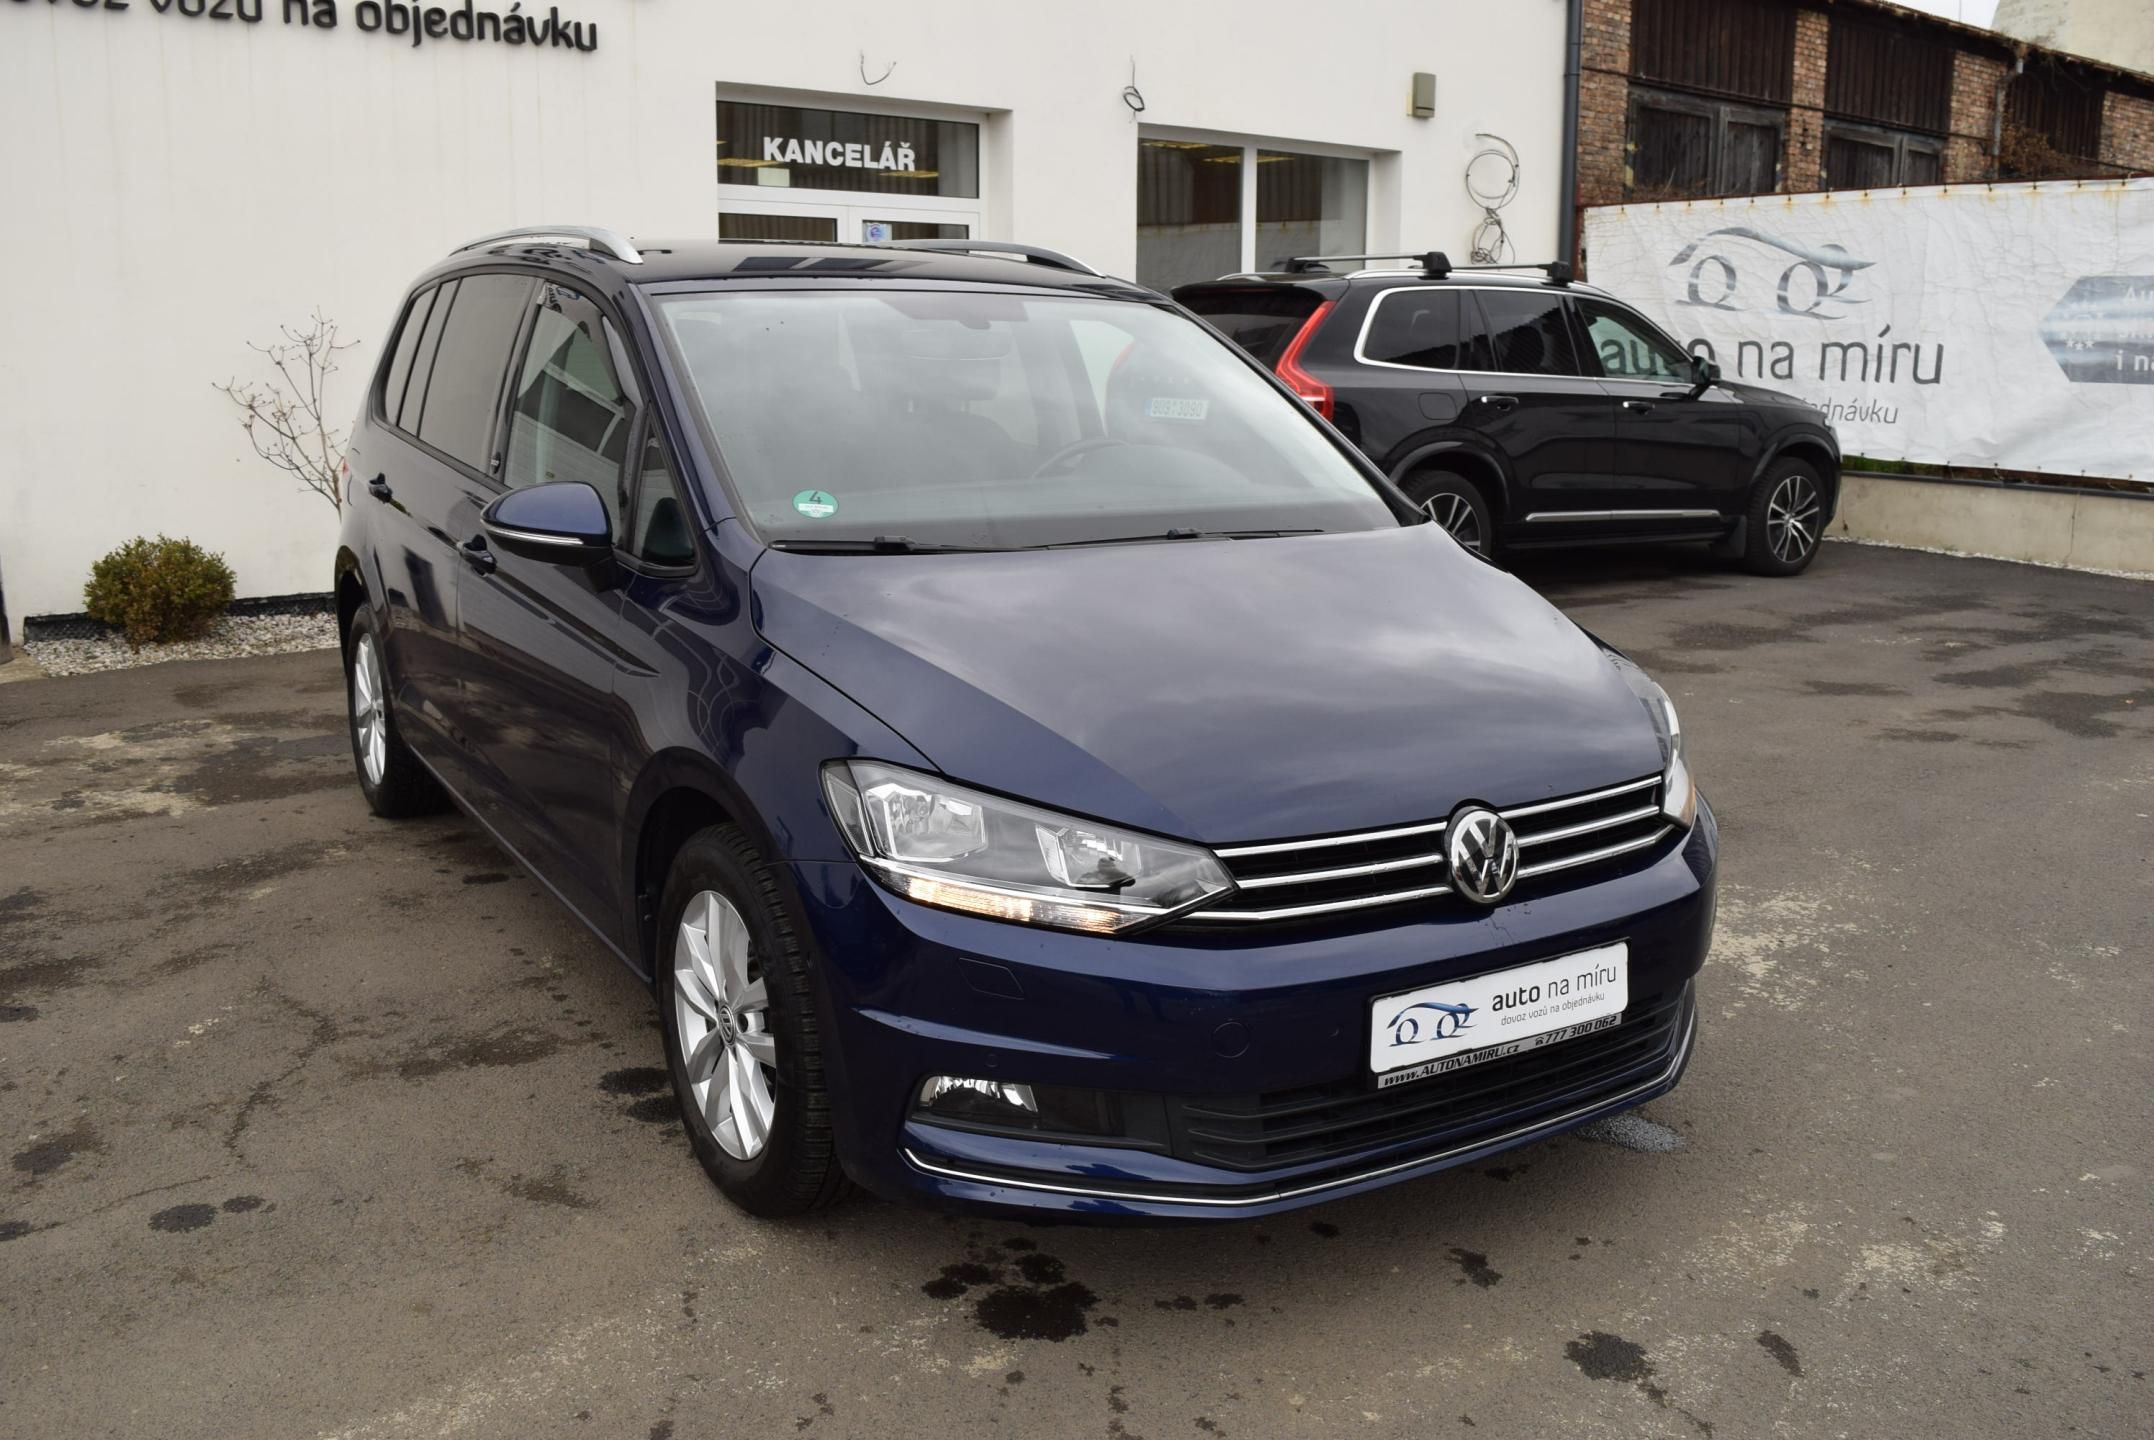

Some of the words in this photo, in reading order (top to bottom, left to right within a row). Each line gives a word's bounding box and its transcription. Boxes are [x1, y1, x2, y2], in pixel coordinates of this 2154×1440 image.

[283, 0, 337, 28] na
[355, 0, 597, 50] objednávku
[763, 136, 916, 172] KANCELÁŘ
[1600, 338, 1716, 376] auo
[1737, 339, 1795, 380] na
[1819, 323, 1944, 385] míru
[2115, 349, 2124, 371] i
[2134, 354, 2154, 371] n
[809, 490, 823, 505] 4
[1492, 986, 1540, 1011] auto
[1548, 979, 1569, 999] na
[1577, 963, 1616, 991] míru
[1501, 1012, 1527, 1026] dovoz
[1528, 1006, 1548, 1019] vozů
[1550, 1004, 1560, 1014] na
[1562, 992, 1605, 1012] objednávku
[1545, 1029, 1568, 1044] 777
[1569, 1022, 1593, 1038] 300
[1594, 1015, 1617, 1031] 062
